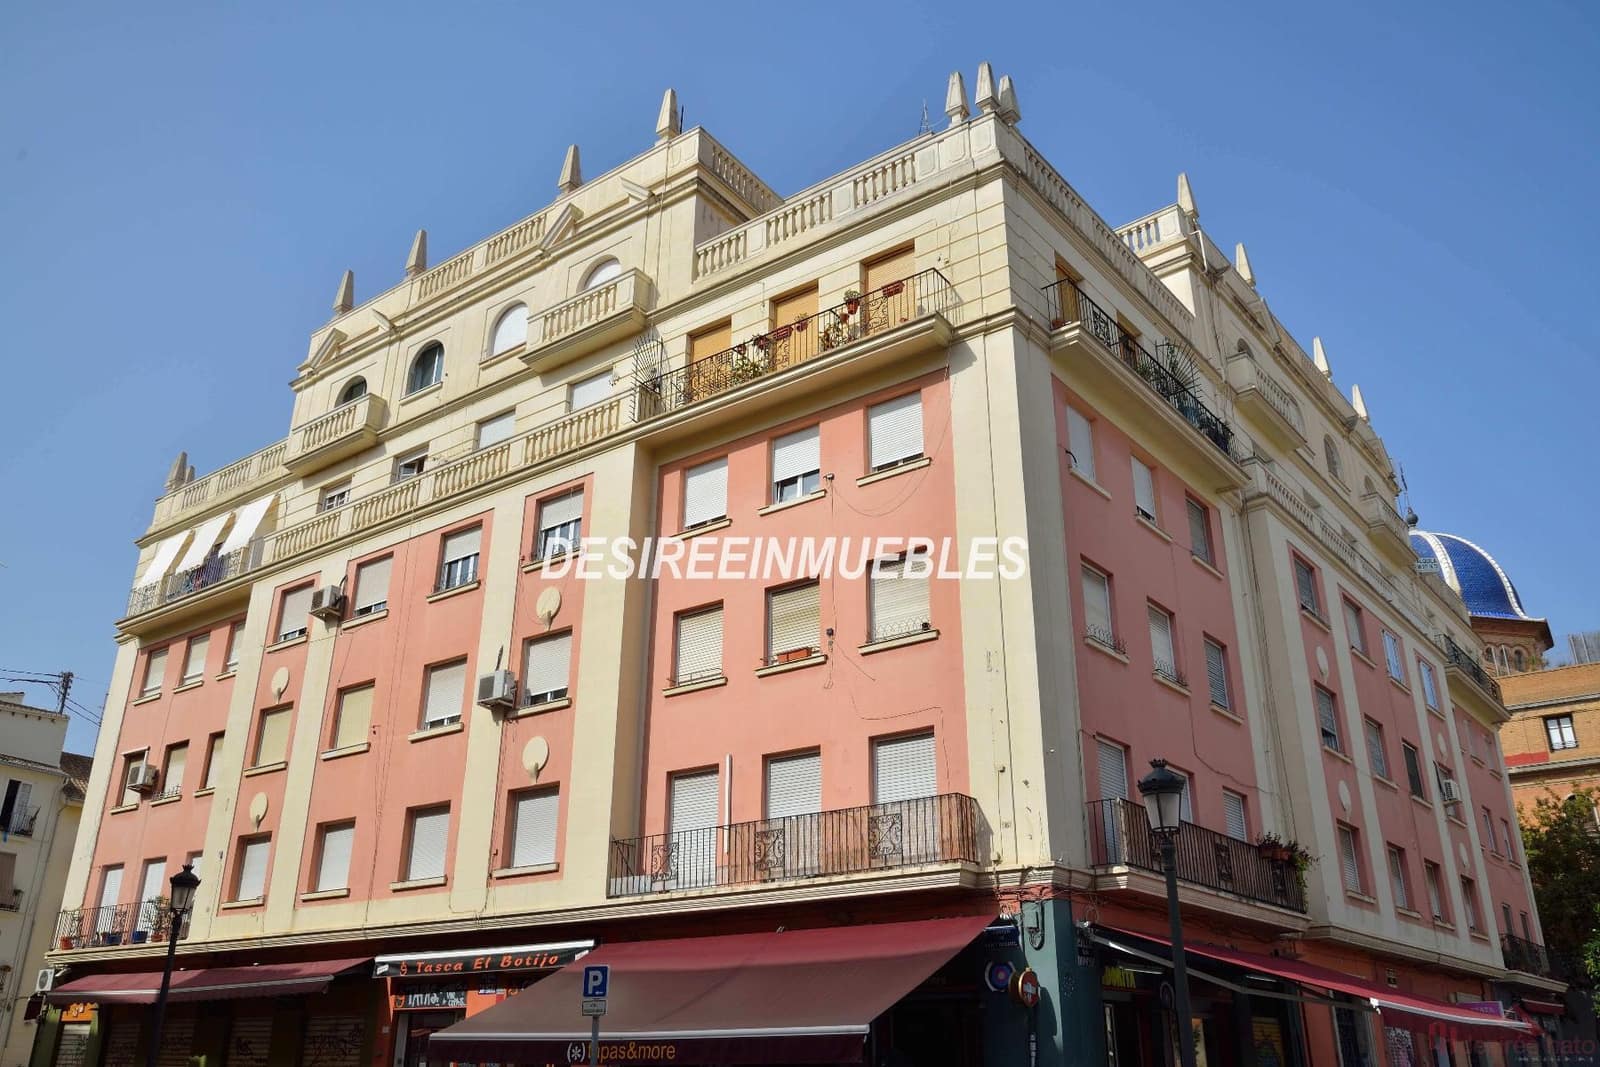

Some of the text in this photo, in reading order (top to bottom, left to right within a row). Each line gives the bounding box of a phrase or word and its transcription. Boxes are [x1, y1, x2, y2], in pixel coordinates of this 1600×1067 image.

[416, 953, 560, 973] Tasca El Botijo
[588, 970, 603, 995] P
[588, 1041, 676, 1062] tpas&more
